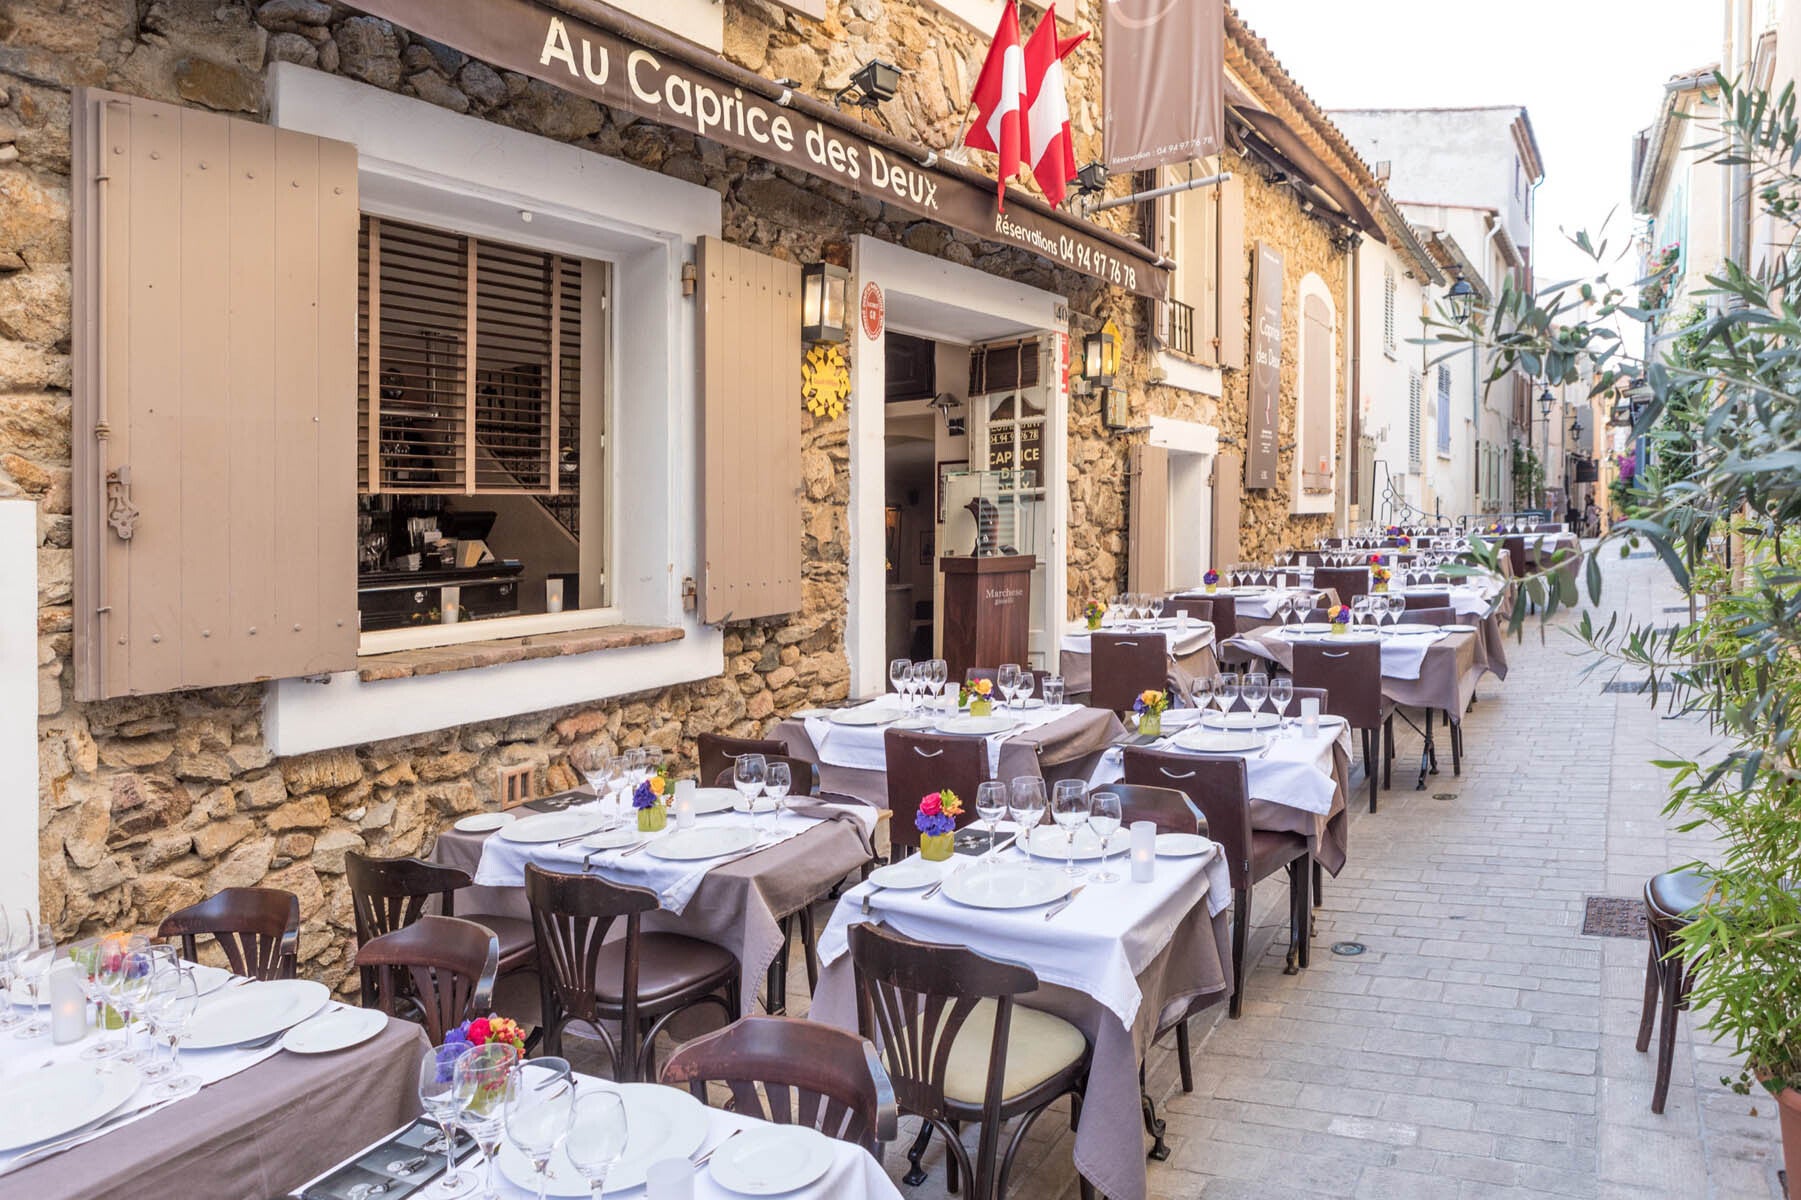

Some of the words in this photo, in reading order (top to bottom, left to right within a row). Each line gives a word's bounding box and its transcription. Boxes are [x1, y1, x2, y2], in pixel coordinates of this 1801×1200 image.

[539, 16, 609, 85] Au
[627, 49, 794, 152] Caprice
[805, 121, 860, 179] des
[868, 144, 938, 209] Deux
[1156, 147, 1167, 155] 04
[1168, 144, 1178, 152] 94
[1178, 141, 1189, 150] 97
[995, 213, 1058, 256] Réservations
[1059, 235, 1074, 264] 04
[1076, 243, 1091, 271] 94
[1093, 250, 1106, 277] 97
[1109, 258, 1121, 284] 76
[1123, 264, 1136, 290] 78
[1056, 306, 1068, 321] 40
